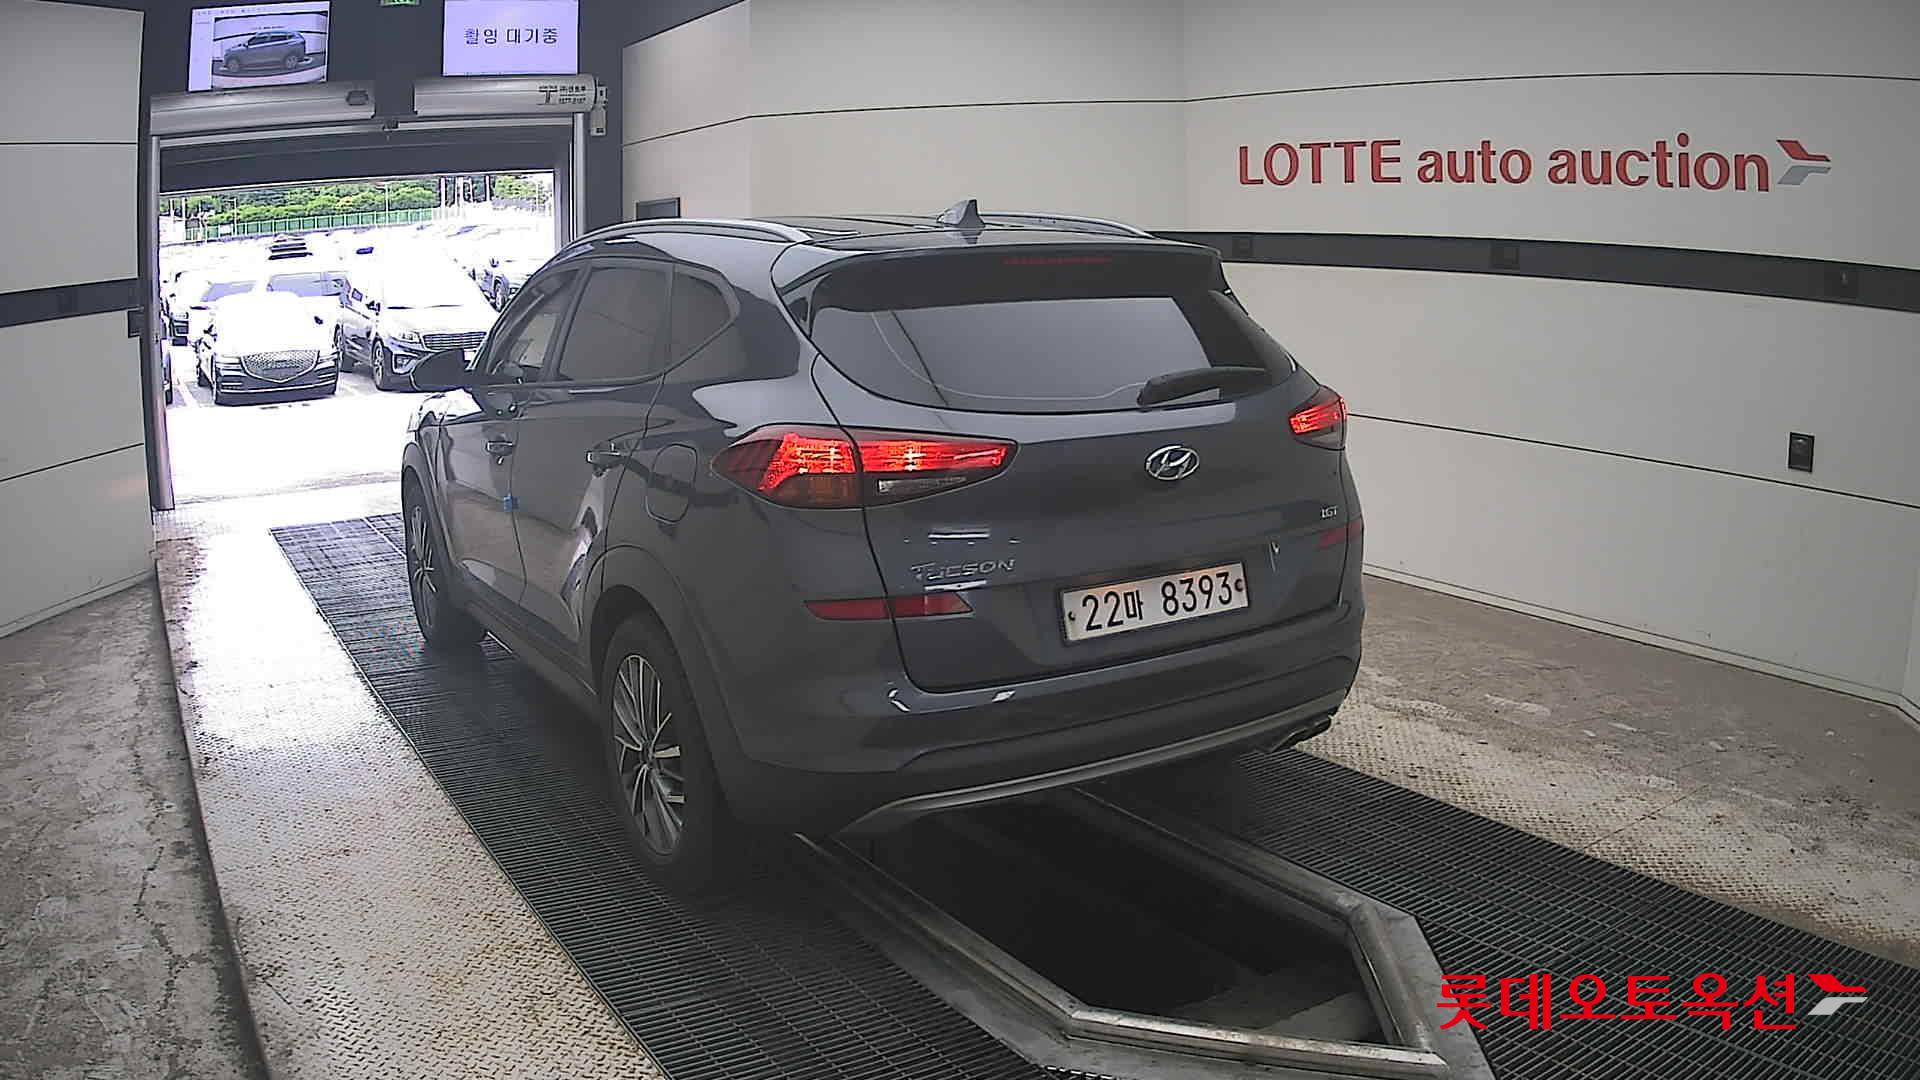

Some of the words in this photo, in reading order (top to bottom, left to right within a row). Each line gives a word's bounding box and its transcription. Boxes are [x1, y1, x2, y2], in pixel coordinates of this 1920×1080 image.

[505, 28, 559, 45] 대기중
[1239, 139, 1401, 186] LOTTE
[1416, 140, 1532, 184] auto
[1547, 132, 1770, 192] auction
[910, 559, 1015, 580] TUCSON
[1082, 589, 1144, 631] 22마
[1161, 571, 1233, 616] 8393
